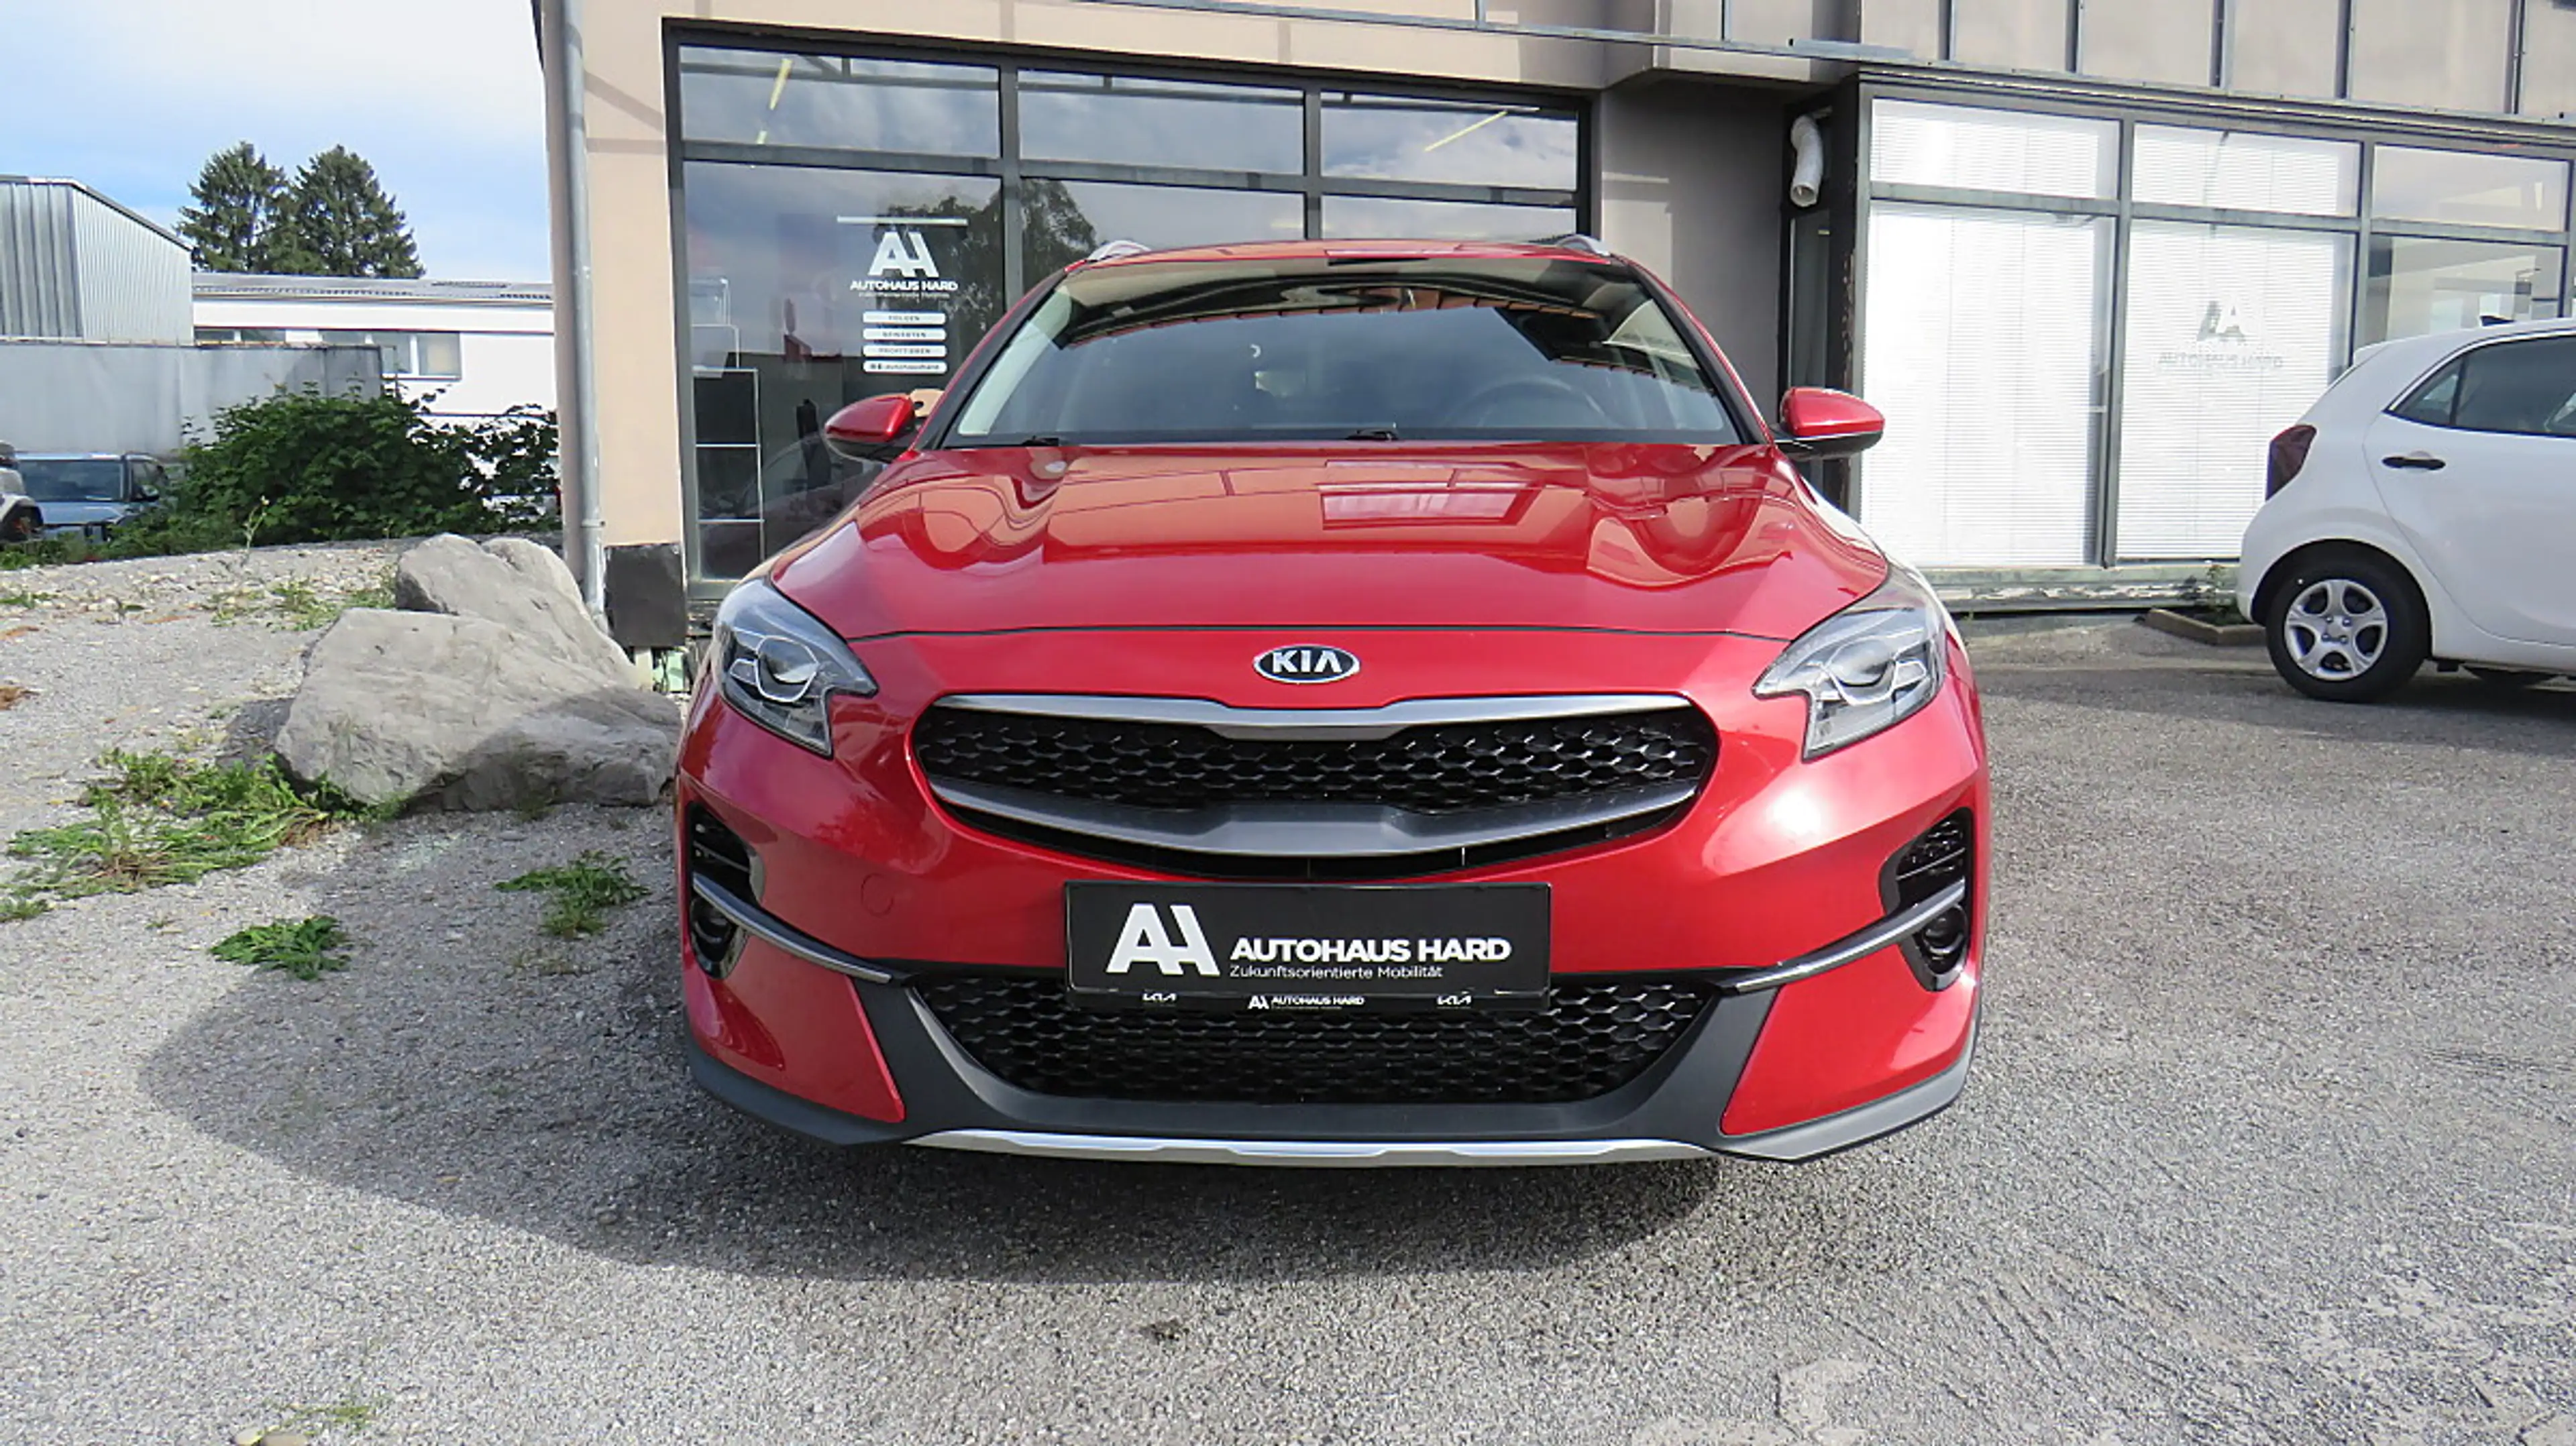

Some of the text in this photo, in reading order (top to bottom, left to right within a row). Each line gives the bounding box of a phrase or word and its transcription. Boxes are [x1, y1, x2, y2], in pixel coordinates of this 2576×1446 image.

[850, 280, 958, 291] AUTOHAUS HARD
[1272, 649, 1342, 673] KIA
[1230, 938, 1512, 962] AUTOHAUS HARD
[1230, 964, 1444, 979] Zukunftsorientierte Mobilität
[1272, 995, 1332, 1005] AUTOHAUS
[1333, 996, 1365, 1005] HARD
